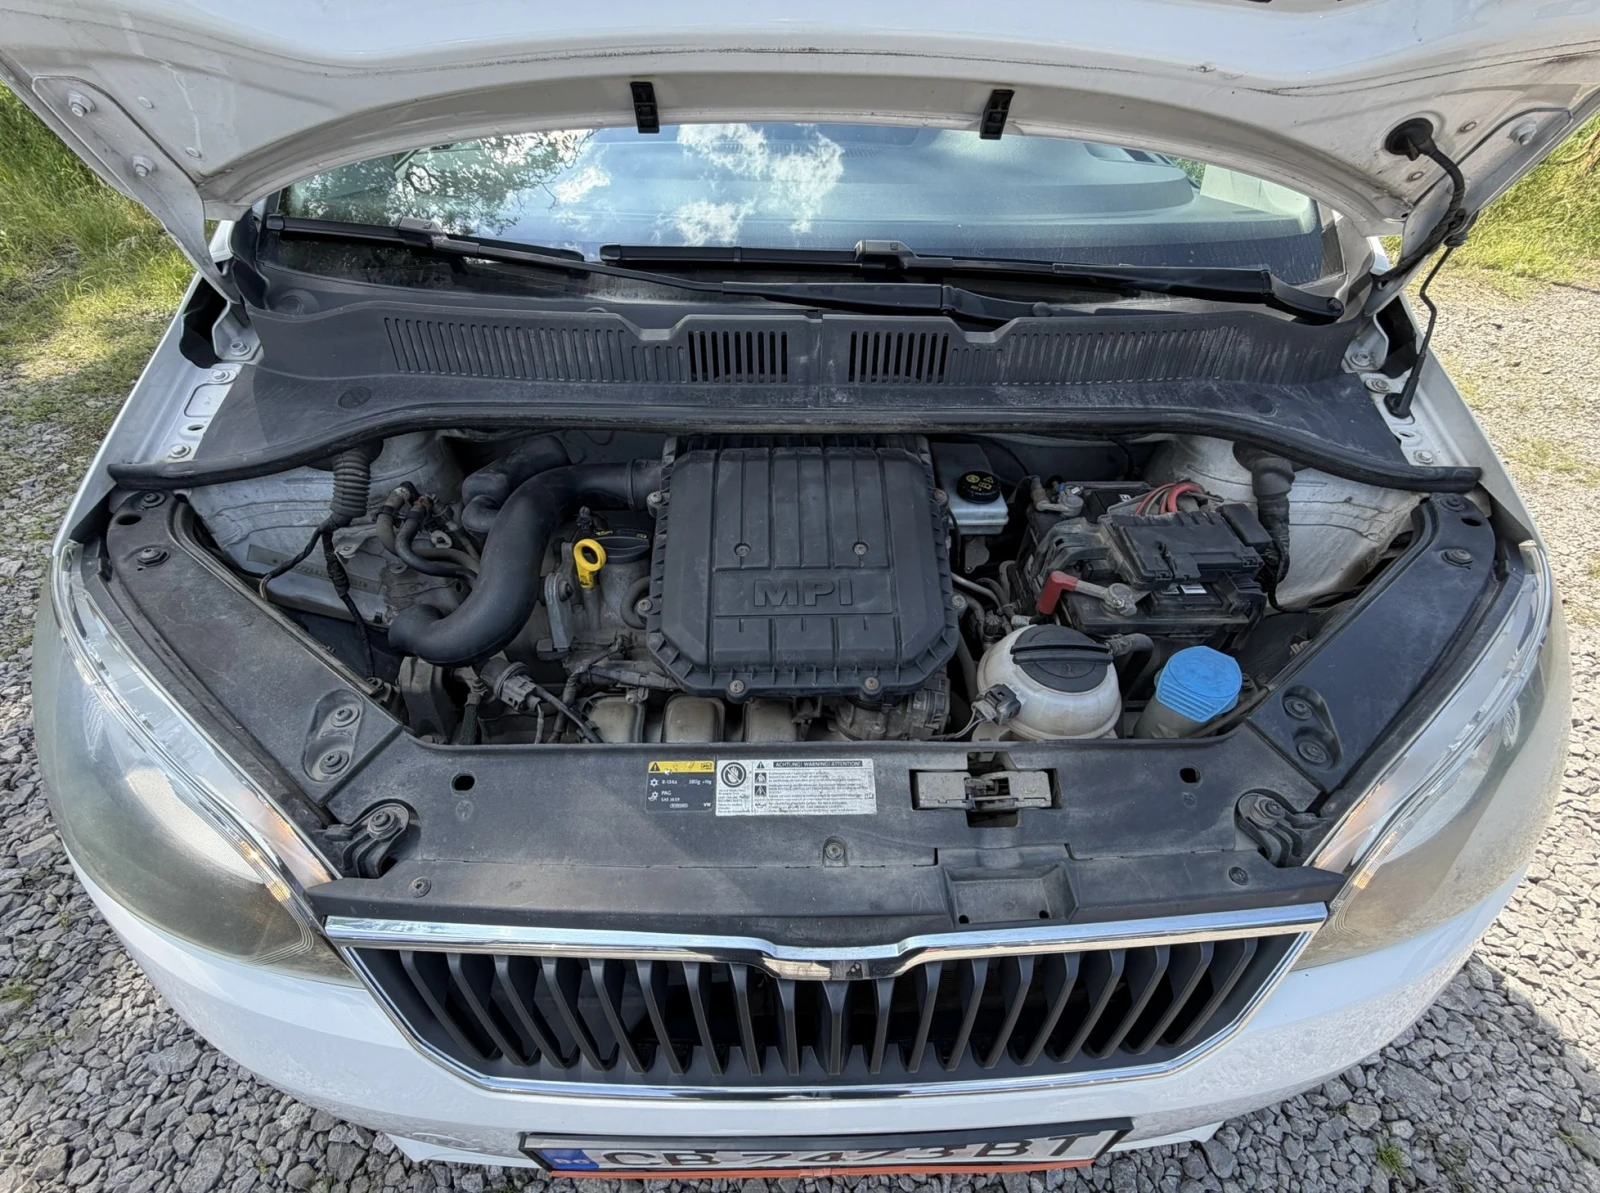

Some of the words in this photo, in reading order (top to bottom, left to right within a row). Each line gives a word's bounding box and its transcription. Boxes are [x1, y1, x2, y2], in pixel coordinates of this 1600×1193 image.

[754, 578, 853, 607] MPI
[602, 1150, 721, 1166] CB
[741, 1146, 960, 1165] 7473
[972, 1132, 1100, 1158] BT
